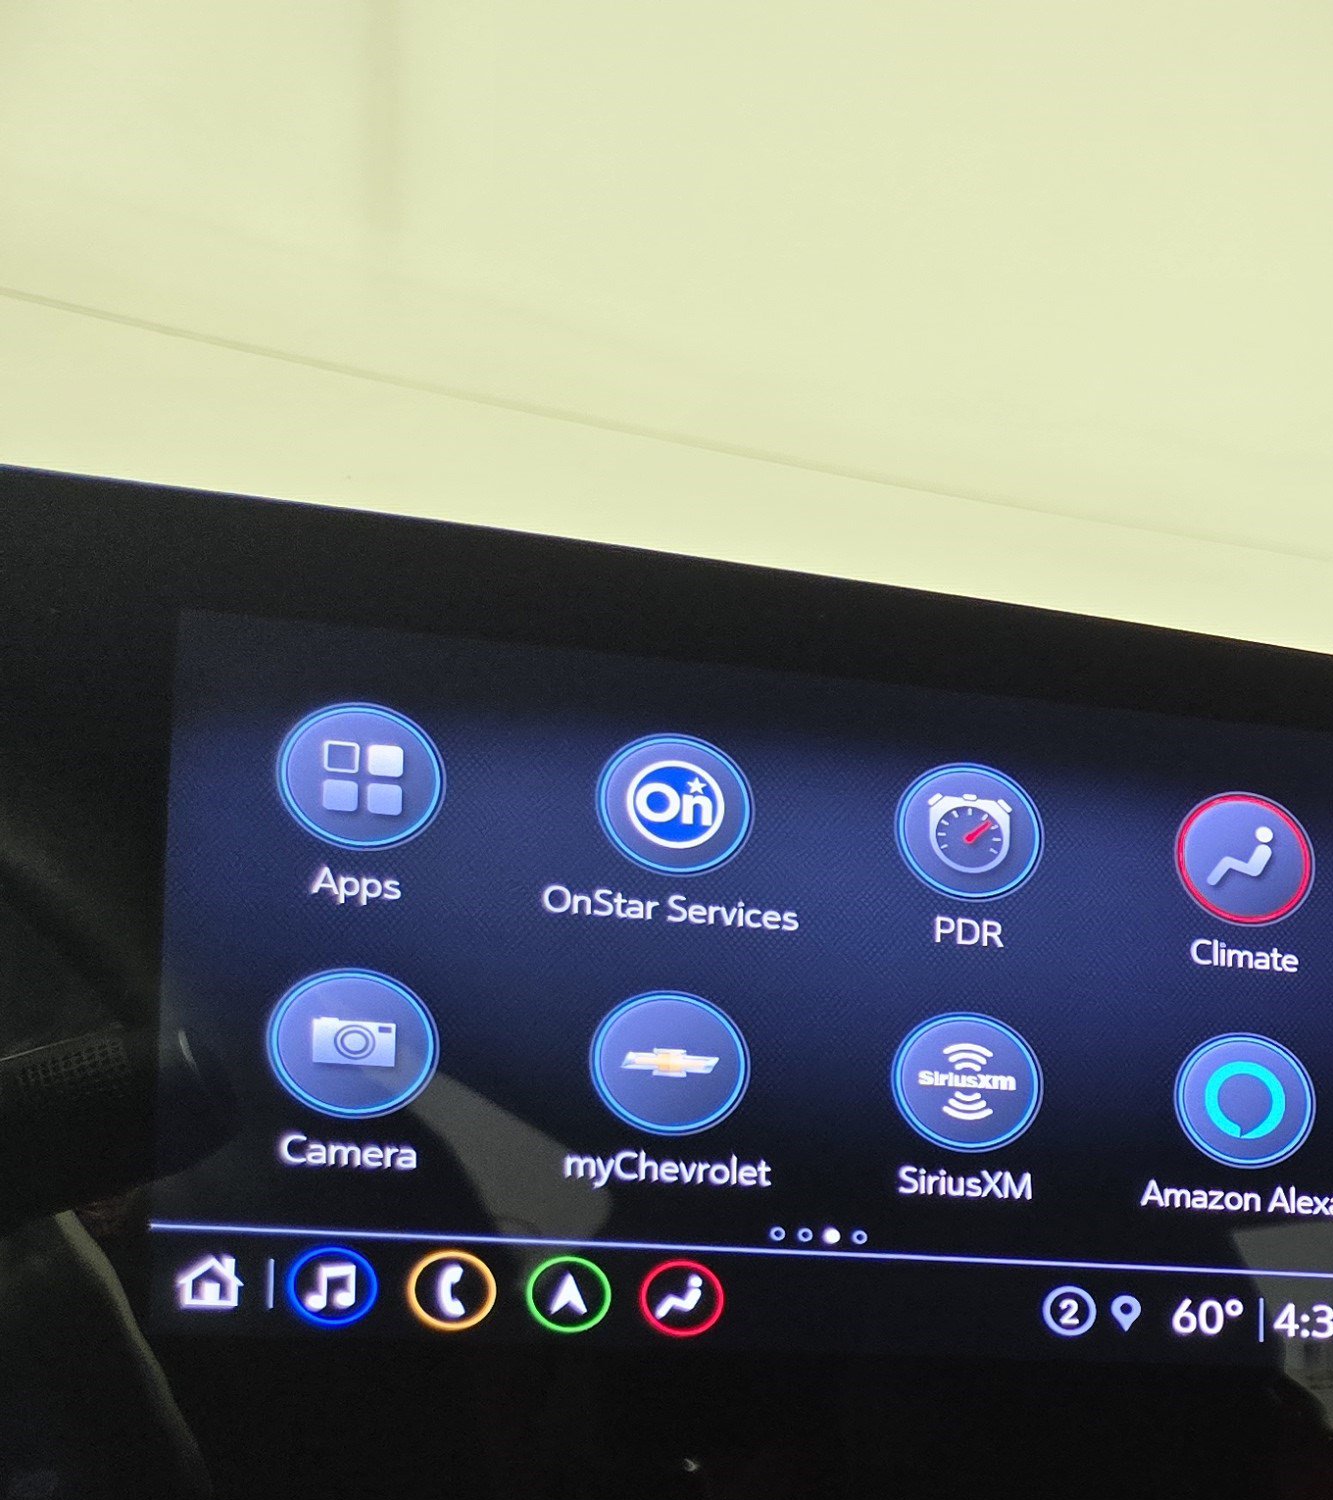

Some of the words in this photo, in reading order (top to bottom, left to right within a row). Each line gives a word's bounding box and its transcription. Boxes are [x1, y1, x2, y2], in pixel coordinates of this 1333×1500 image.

[311, 867, 402, 905] Apps
[541, 885, 659, 921] OnStar
[667, 896, 800, 932] Services
[933, 916, 1004, 949] PDR
[1190, 938, 1300, 973] Climate
[279, 1134, 417, 1170] Camera
[563, 1150, 772, 1188] myChevrolet
[898, 1165, 1033, 1201] SiriusXM
[1140, 1179, 1261, 1213] Amazon
[1058, 1300, 1080, 1326] 2
[1172, 1298, 1244, 1336] 60°
